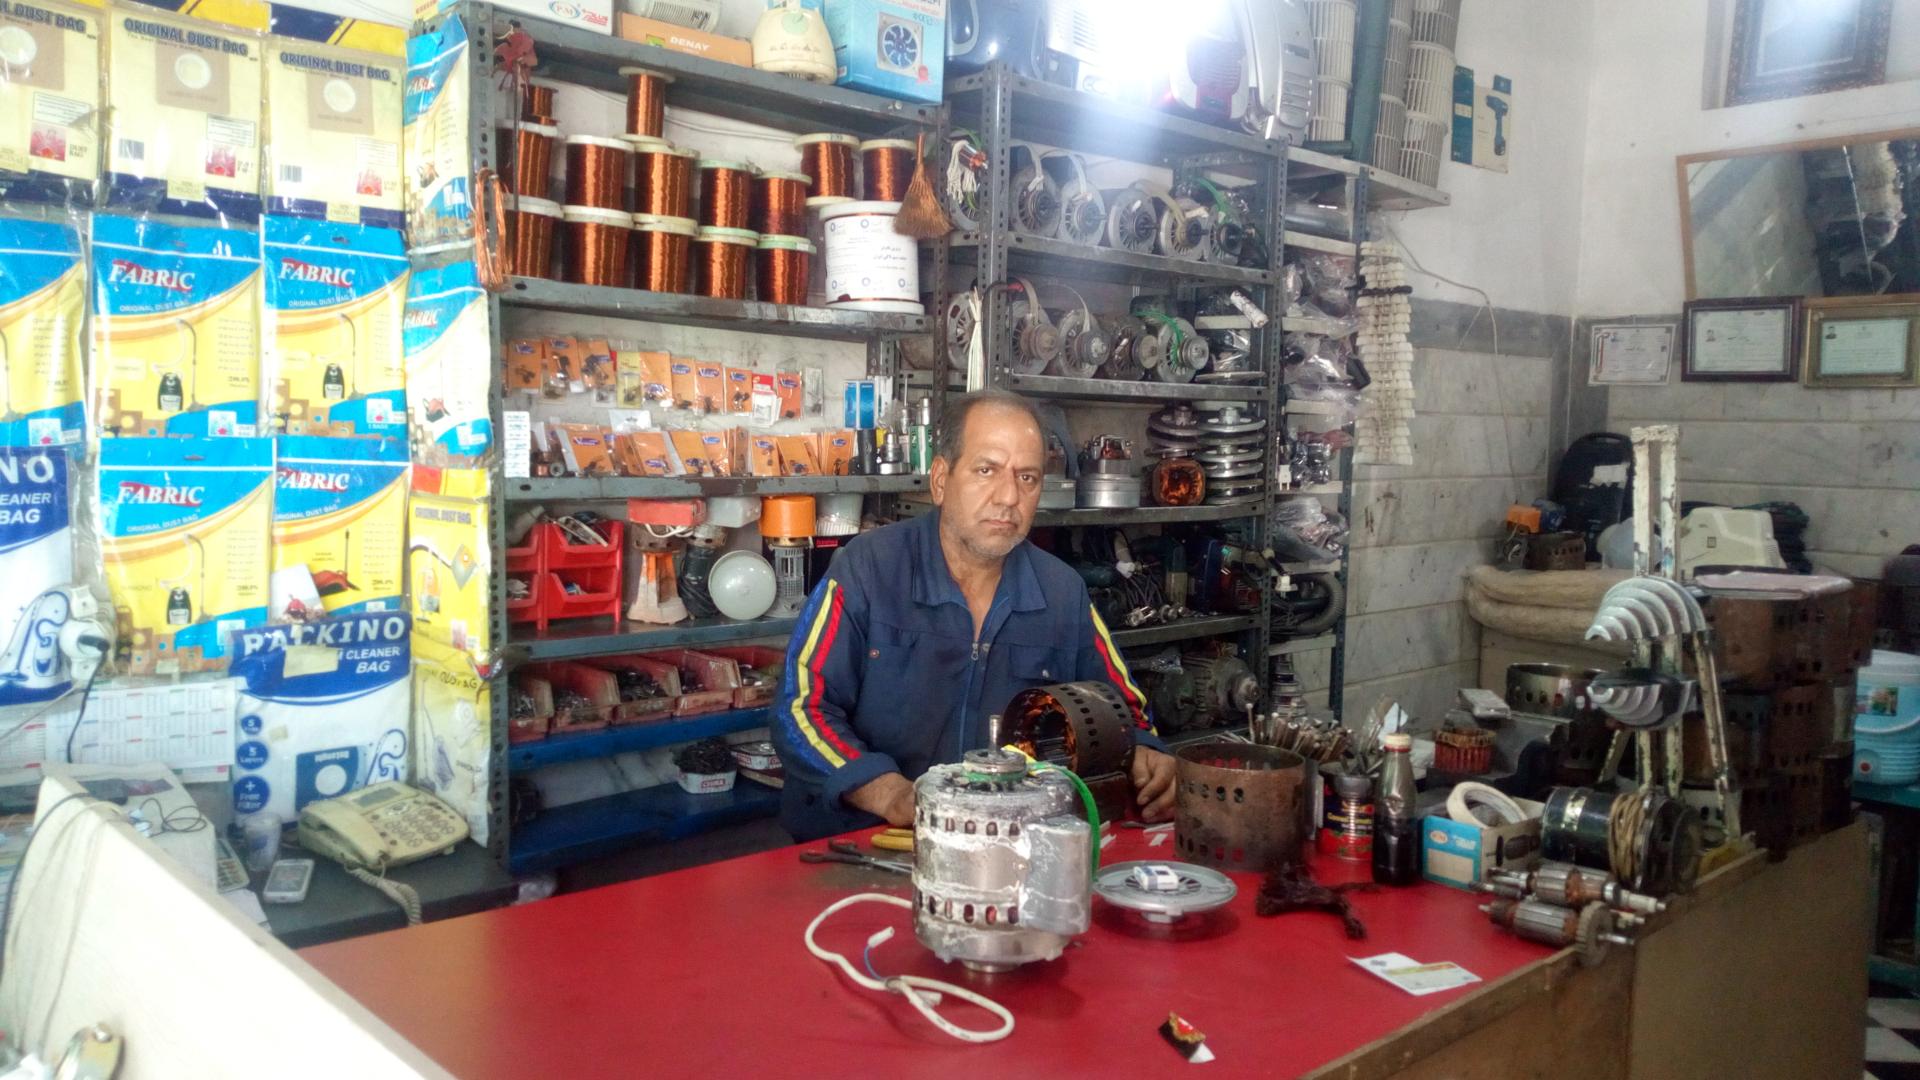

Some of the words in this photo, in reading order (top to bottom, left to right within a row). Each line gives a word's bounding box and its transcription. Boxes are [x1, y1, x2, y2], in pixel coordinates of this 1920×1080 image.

[14, 3, 53, 25] DUST
[55, 13, 86, 34] BAG
[124, 18, 185, 43] ORIGINAL
[187, 31, 220, 51] DUST
[222, 39, 249, 57] BAG
[671, 36, 710, 51] DENAY
[280, 51, 334, 72] ORIGINAL
[335, 60, 364, 77] DUST
[366, 66, 391, 82] BAG
[109, 263, 196, 290] FABRIC
[278, 262, 356, 286] FABRIC
[119, 304, 153, 312] ORIGINAL
[288, 299, 318, 307] ORIGINAL
[117, 486, 205, 505] FABRIC
[0, 508, 40, 524] BAG
[127, 524, 161, 532] ORIGINAL
[162, 518, 182, 529] DUST
[183, 514, 198, 523] BAG
[346, 647, 401, 661] CLEANER
[356, 660, 391, 675] BAG
